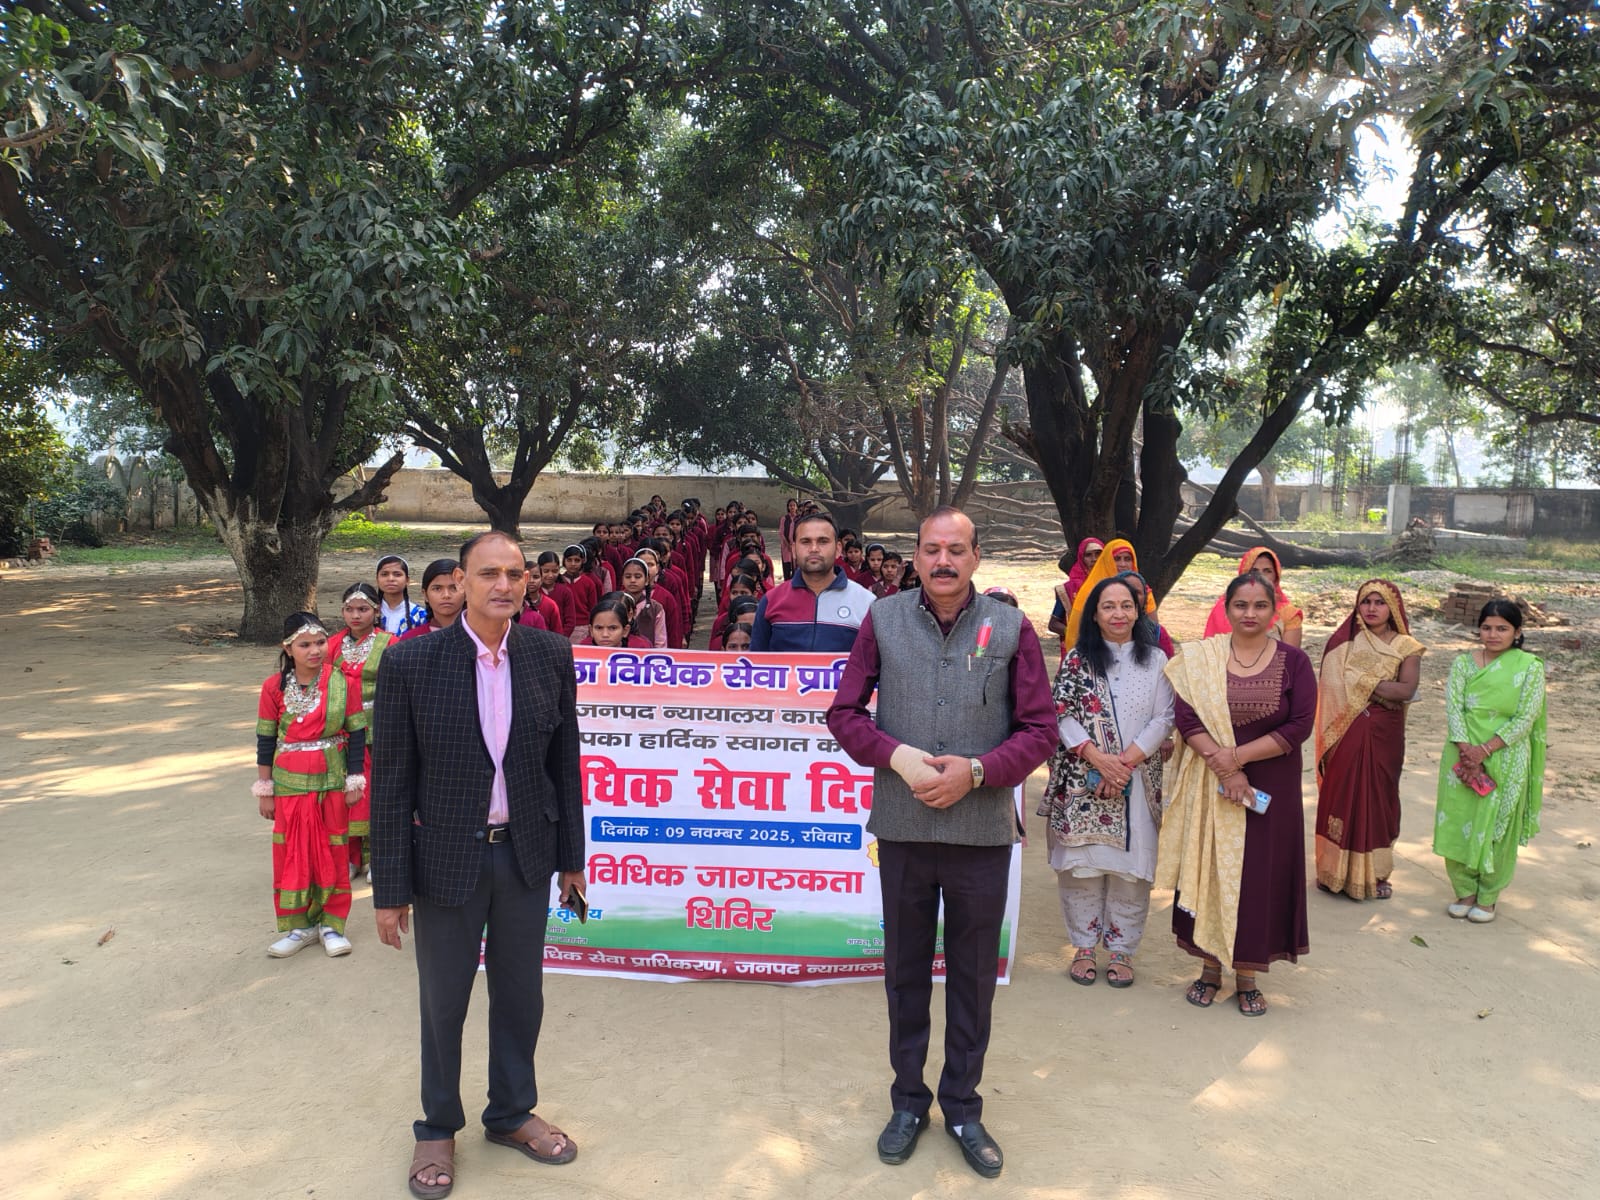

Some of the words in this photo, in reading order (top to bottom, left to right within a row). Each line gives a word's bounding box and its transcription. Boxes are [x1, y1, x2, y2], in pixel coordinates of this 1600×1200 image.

[607, 653, 715, 687] विधिक
[723, 658, 789, 689] सेवा
[663, 706, 776, 724] न्यायालय
[579, 732, 632, 747] पका
[639, 728, 719, 750] हार्दिक
[726, 736, 810, 753] स्वागत
[579, 755, 678, 807] धिक
[693, 758, 791, 812] सेवा
[600, 821, 649, 837] दिनांक
[665, 826, 686, 838] 09
[690, 827, 744, 840] नवम्बर
[750, 829, 796, 843] 2025,
[801, 826, 853, 844] रविवार
[587, 854, 688, 887] विधिक
[685, 896, 777, 931] शिविर
[544, 946, 583, 960] धिक
[588, 951, 626, 965] सेवा
[630, 953, 728, 974] प्राधिकरण,
[735, 961, 802, 975] जनपद
